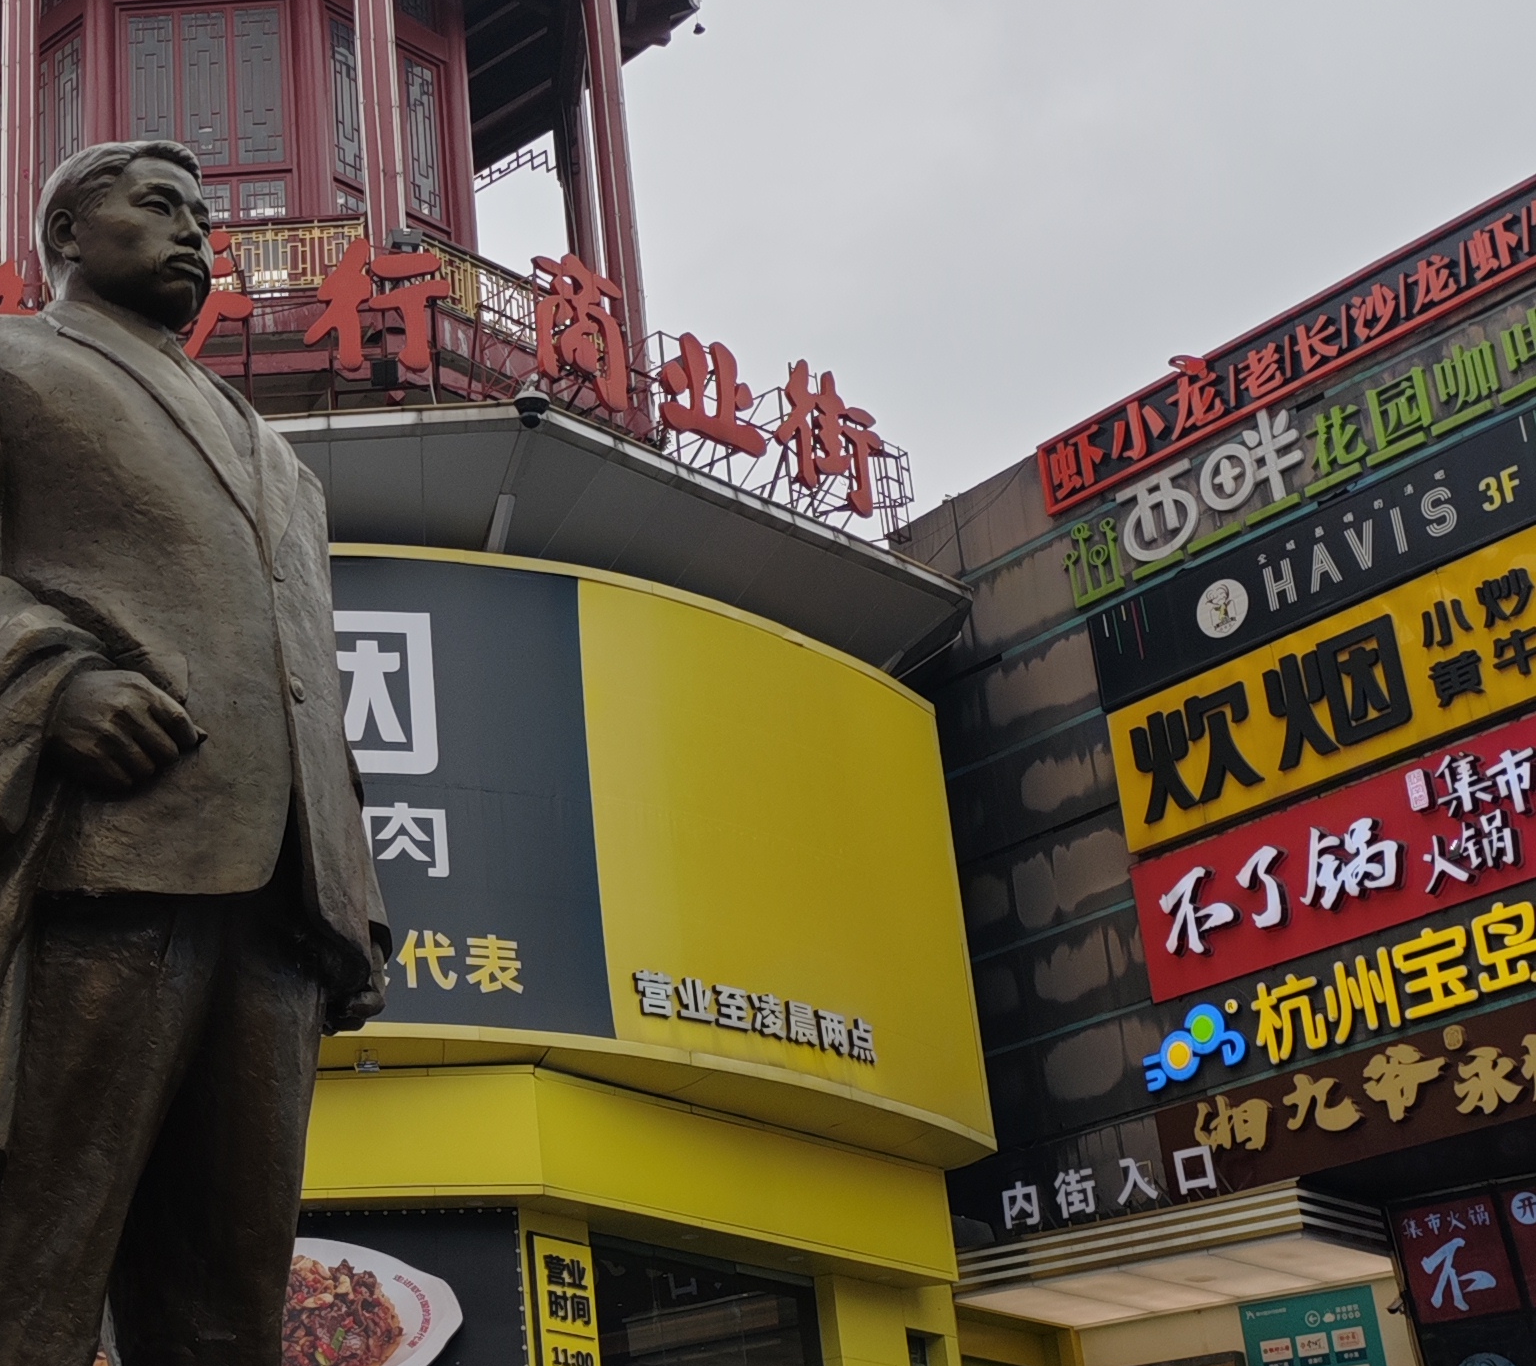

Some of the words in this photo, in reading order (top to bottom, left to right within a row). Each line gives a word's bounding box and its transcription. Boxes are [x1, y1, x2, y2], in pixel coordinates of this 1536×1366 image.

[1262, 486, 1458, 612] HAVIS
[1478, 465, 1520, 512] 3F
[1435, 747, 1536, 817] 集市
[1158, 817, 1398, 955] 不了锅
[1422, 808, 1516, 894] 火锅
[383, 929, 524, 995] 代表
[633, 969, 876, 1063] 营业至凌晨两点
[1194, 1033, 1536, 1153] 湘九爷永
[1002, 1145, 1218, 1230] 内街入口
[544, 1254, 588, 1291] 营业
[548, 1290, 592, 1327] 时间
